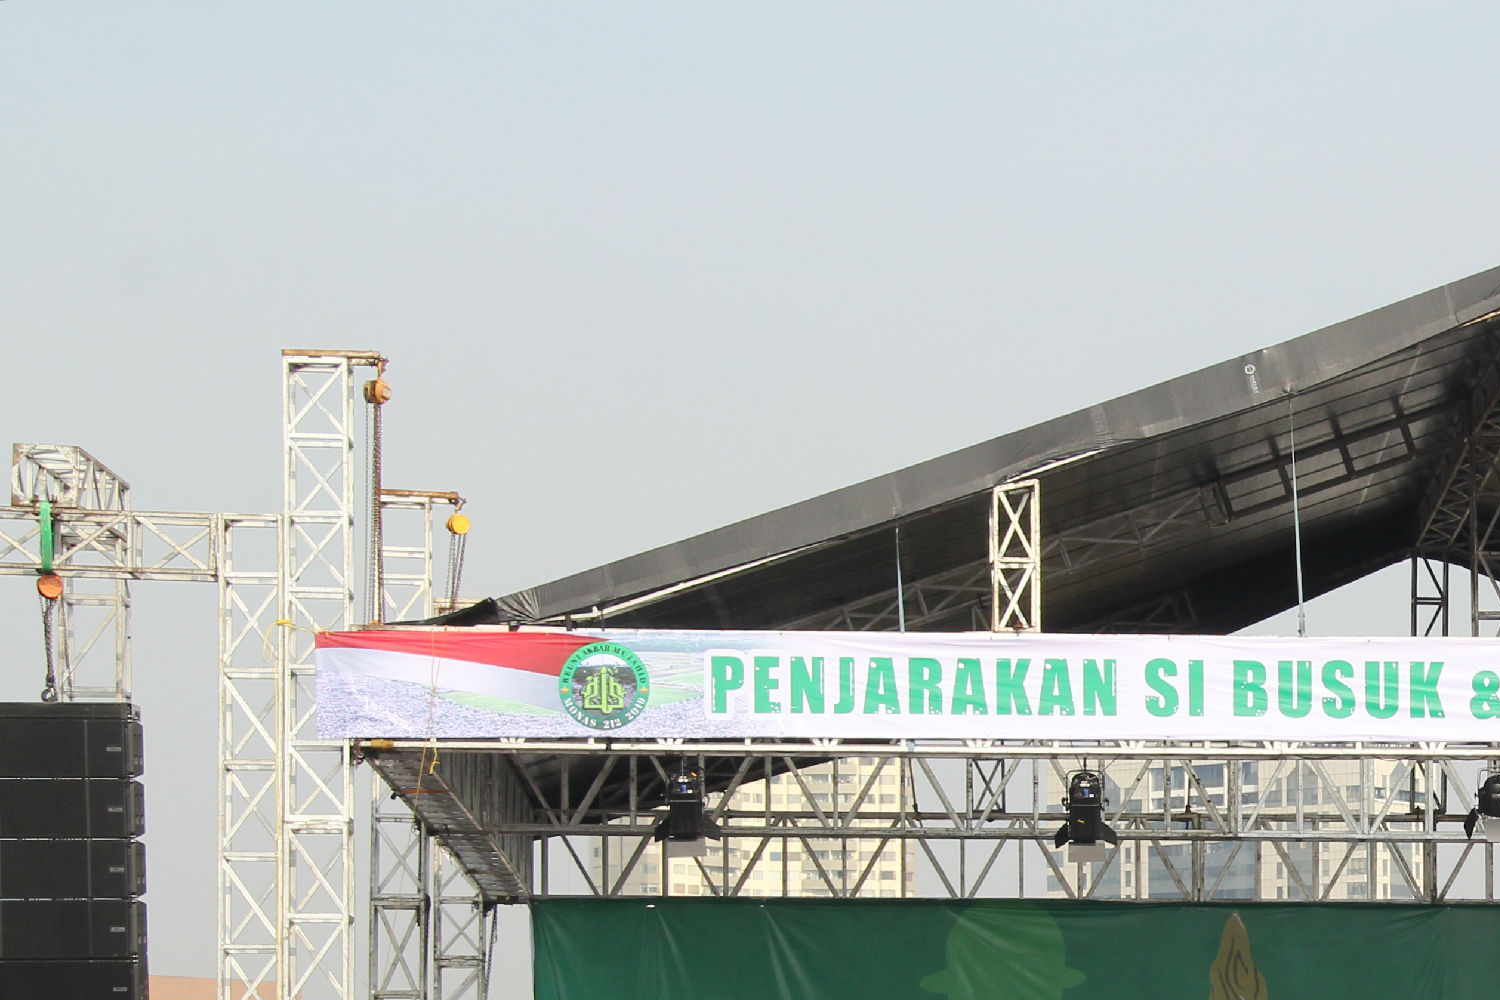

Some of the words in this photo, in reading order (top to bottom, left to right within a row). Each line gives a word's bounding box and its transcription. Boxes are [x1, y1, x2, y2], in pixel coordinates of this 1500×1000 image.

[714, 657, 1114, 716] PENJARAKAN
[1146, 660, 1204, 717] SI
[1235, 660, 1444, 719] BUSUK
[564, 697, 597, 728] MONAS
[603, 718, 622, 729] 212
